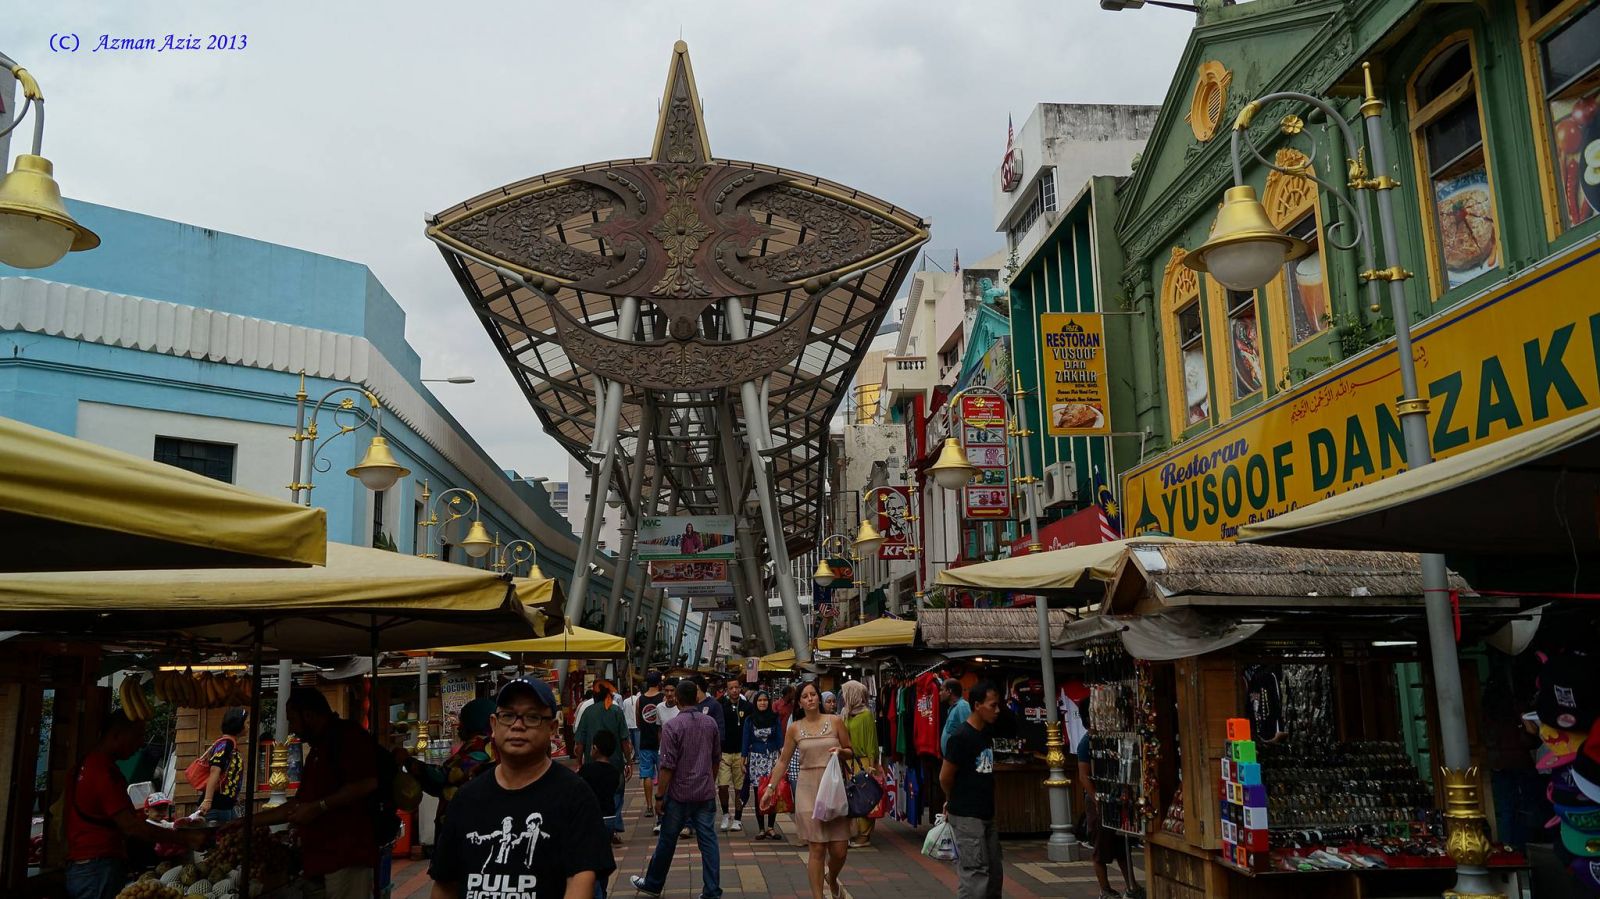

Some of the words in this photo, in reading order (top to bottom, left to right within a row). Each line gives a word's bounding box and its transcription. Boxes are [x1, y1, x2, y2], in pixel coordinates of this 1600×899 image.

[1046, 332, 1100, 348] RESTORAN
[1052, 347, 1097, 361] YUSOOF
[1063, 360, 1086, 370] DAN
[1055, 370, 1097, 384] ZAKHIR
[1160, 438, 1249, 489] Restoran
[1161, 440, 1294, 536] YUSOOF
[1308, 395, 1408, 492] DAN
[883, 545, 913, 556] KFC
[467, 873, 537, 893] PULP
